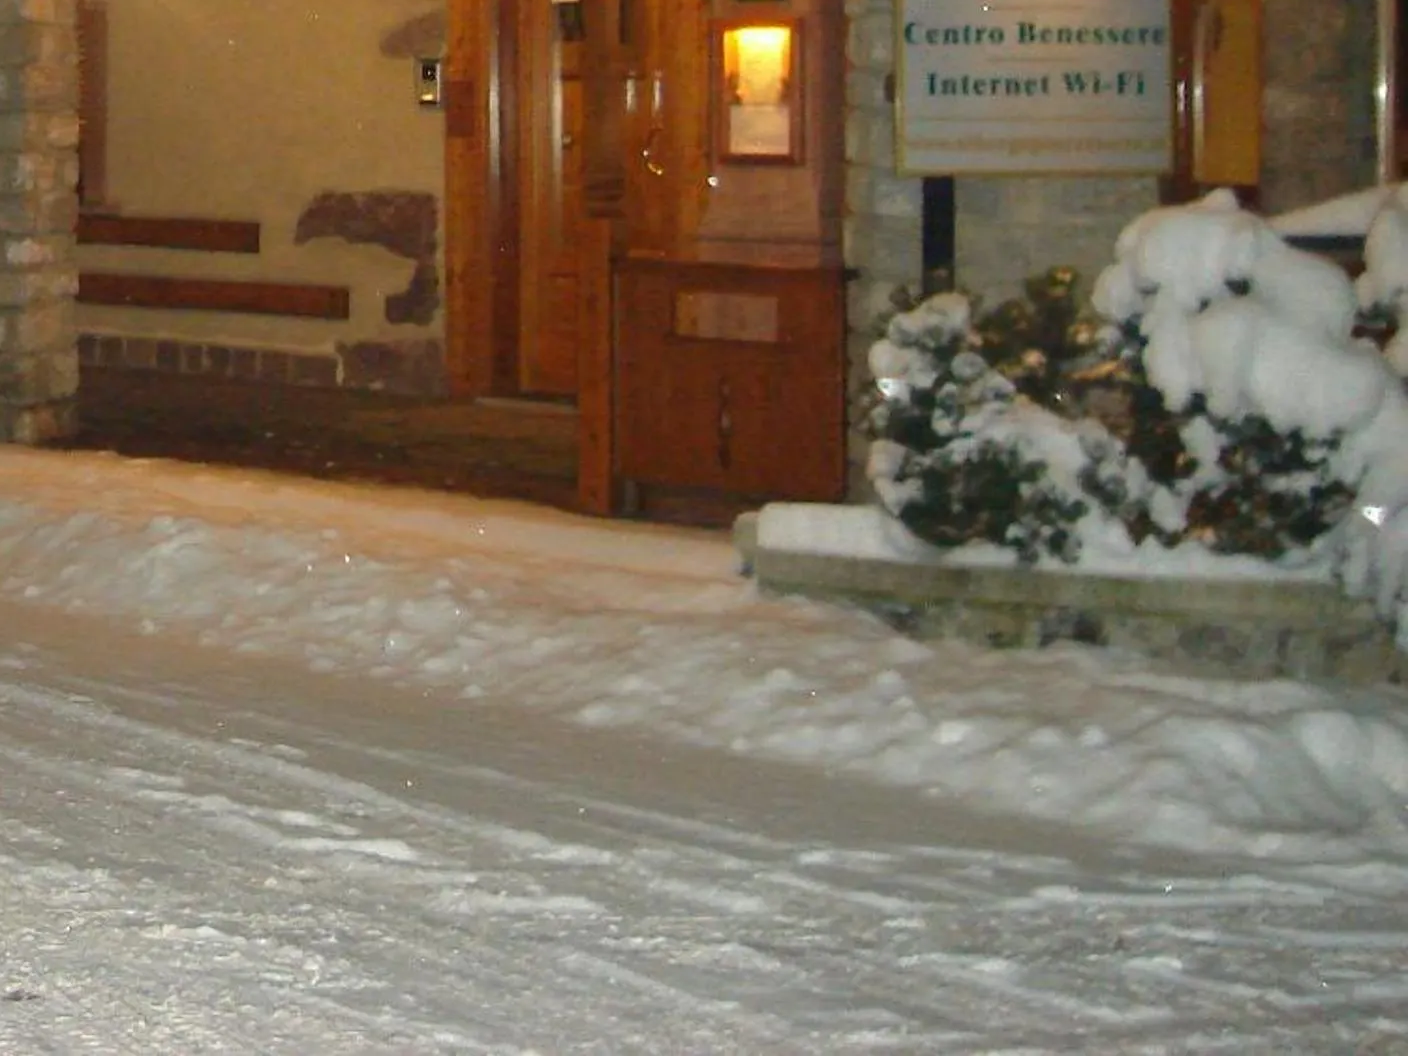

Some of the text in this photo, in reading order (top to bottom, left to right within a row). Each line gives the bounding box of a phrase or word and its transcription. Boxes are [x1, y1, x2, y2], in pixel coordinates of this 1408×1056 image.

[904, 20, 1166, 45] Centro Benessere
[926, 71, 1146, 96] Internet Wi-Fi
